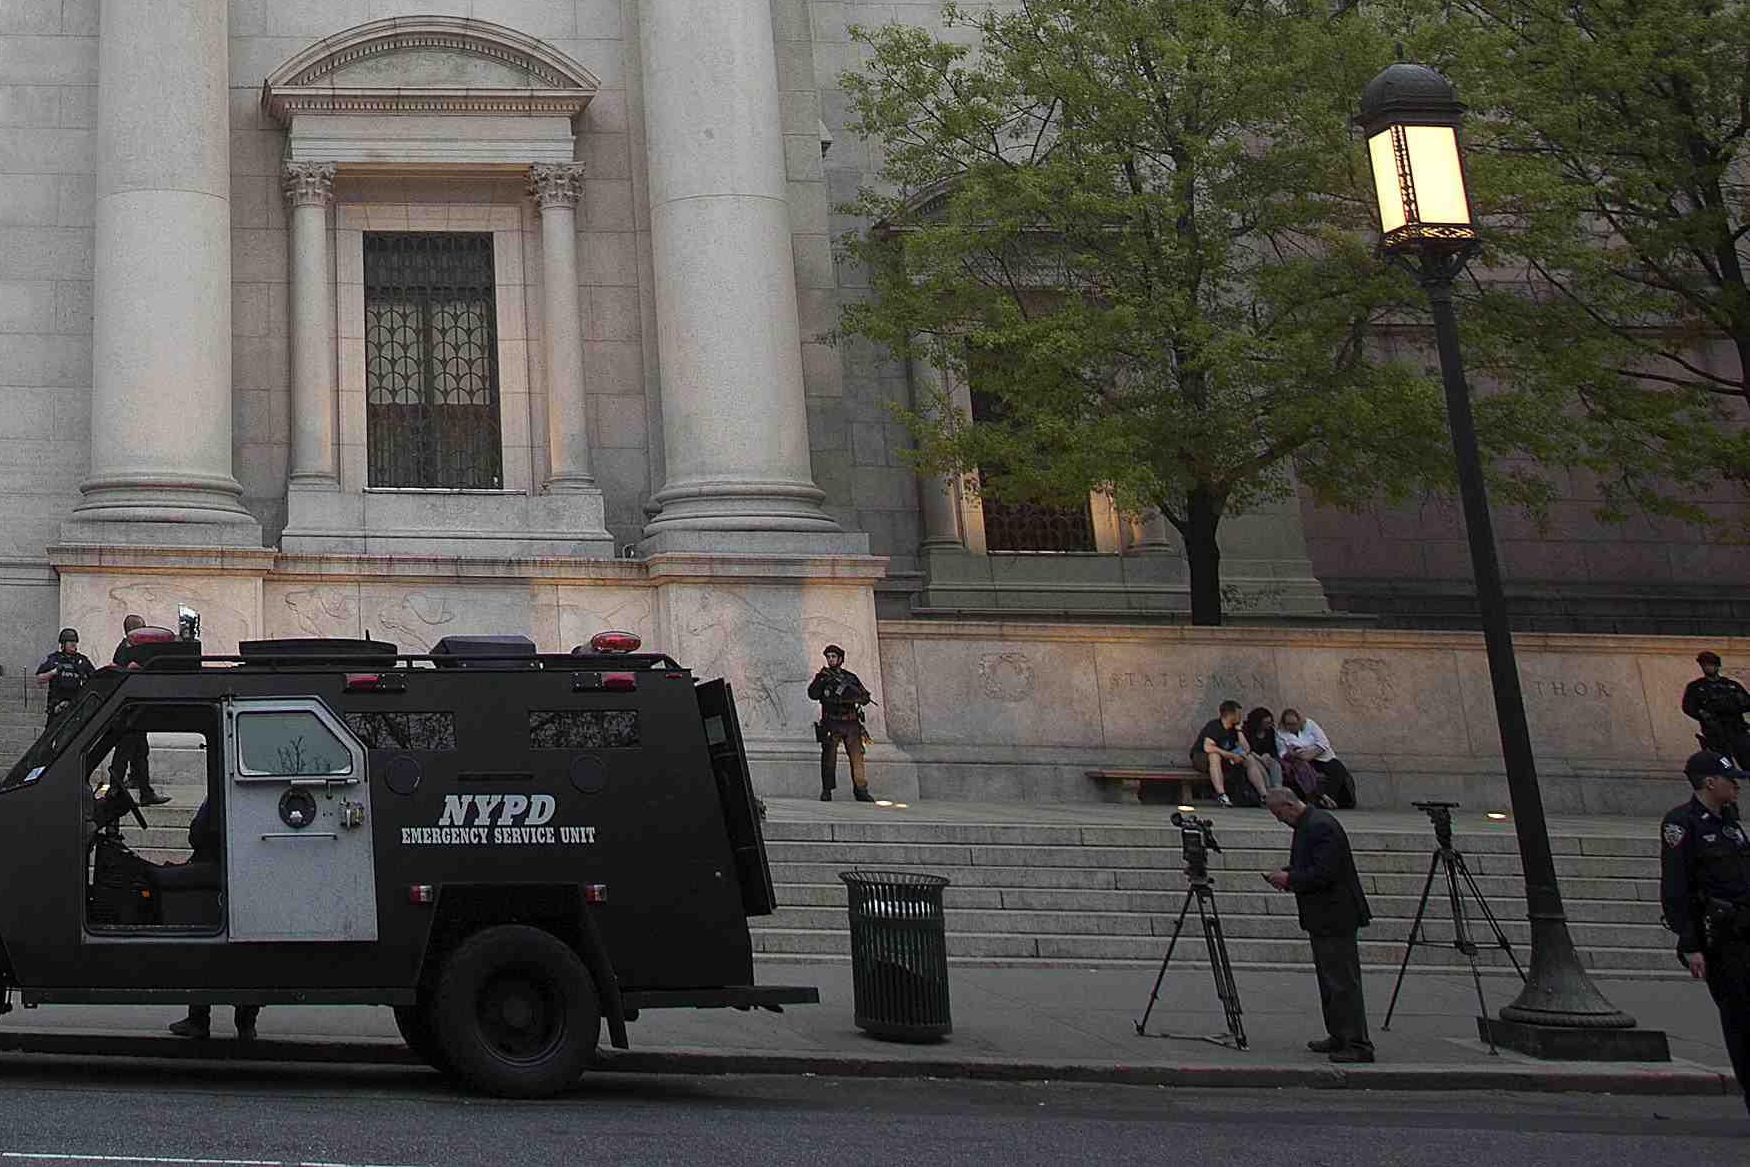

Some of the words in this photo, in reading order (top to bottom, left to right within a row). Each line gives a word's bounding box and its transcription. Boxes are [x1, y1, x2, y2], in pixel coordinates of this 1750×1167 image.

[1111, 672, 1265, 690] STATESMAN
[1532, 681, 1611, 697] THOR
[438, 794, 556, 826] NYPD
[401, 826, 488, 845] EMERGENCY
[494, 826, 555, 844] SERVICE
[560, 826, 596, 844] UNIT
